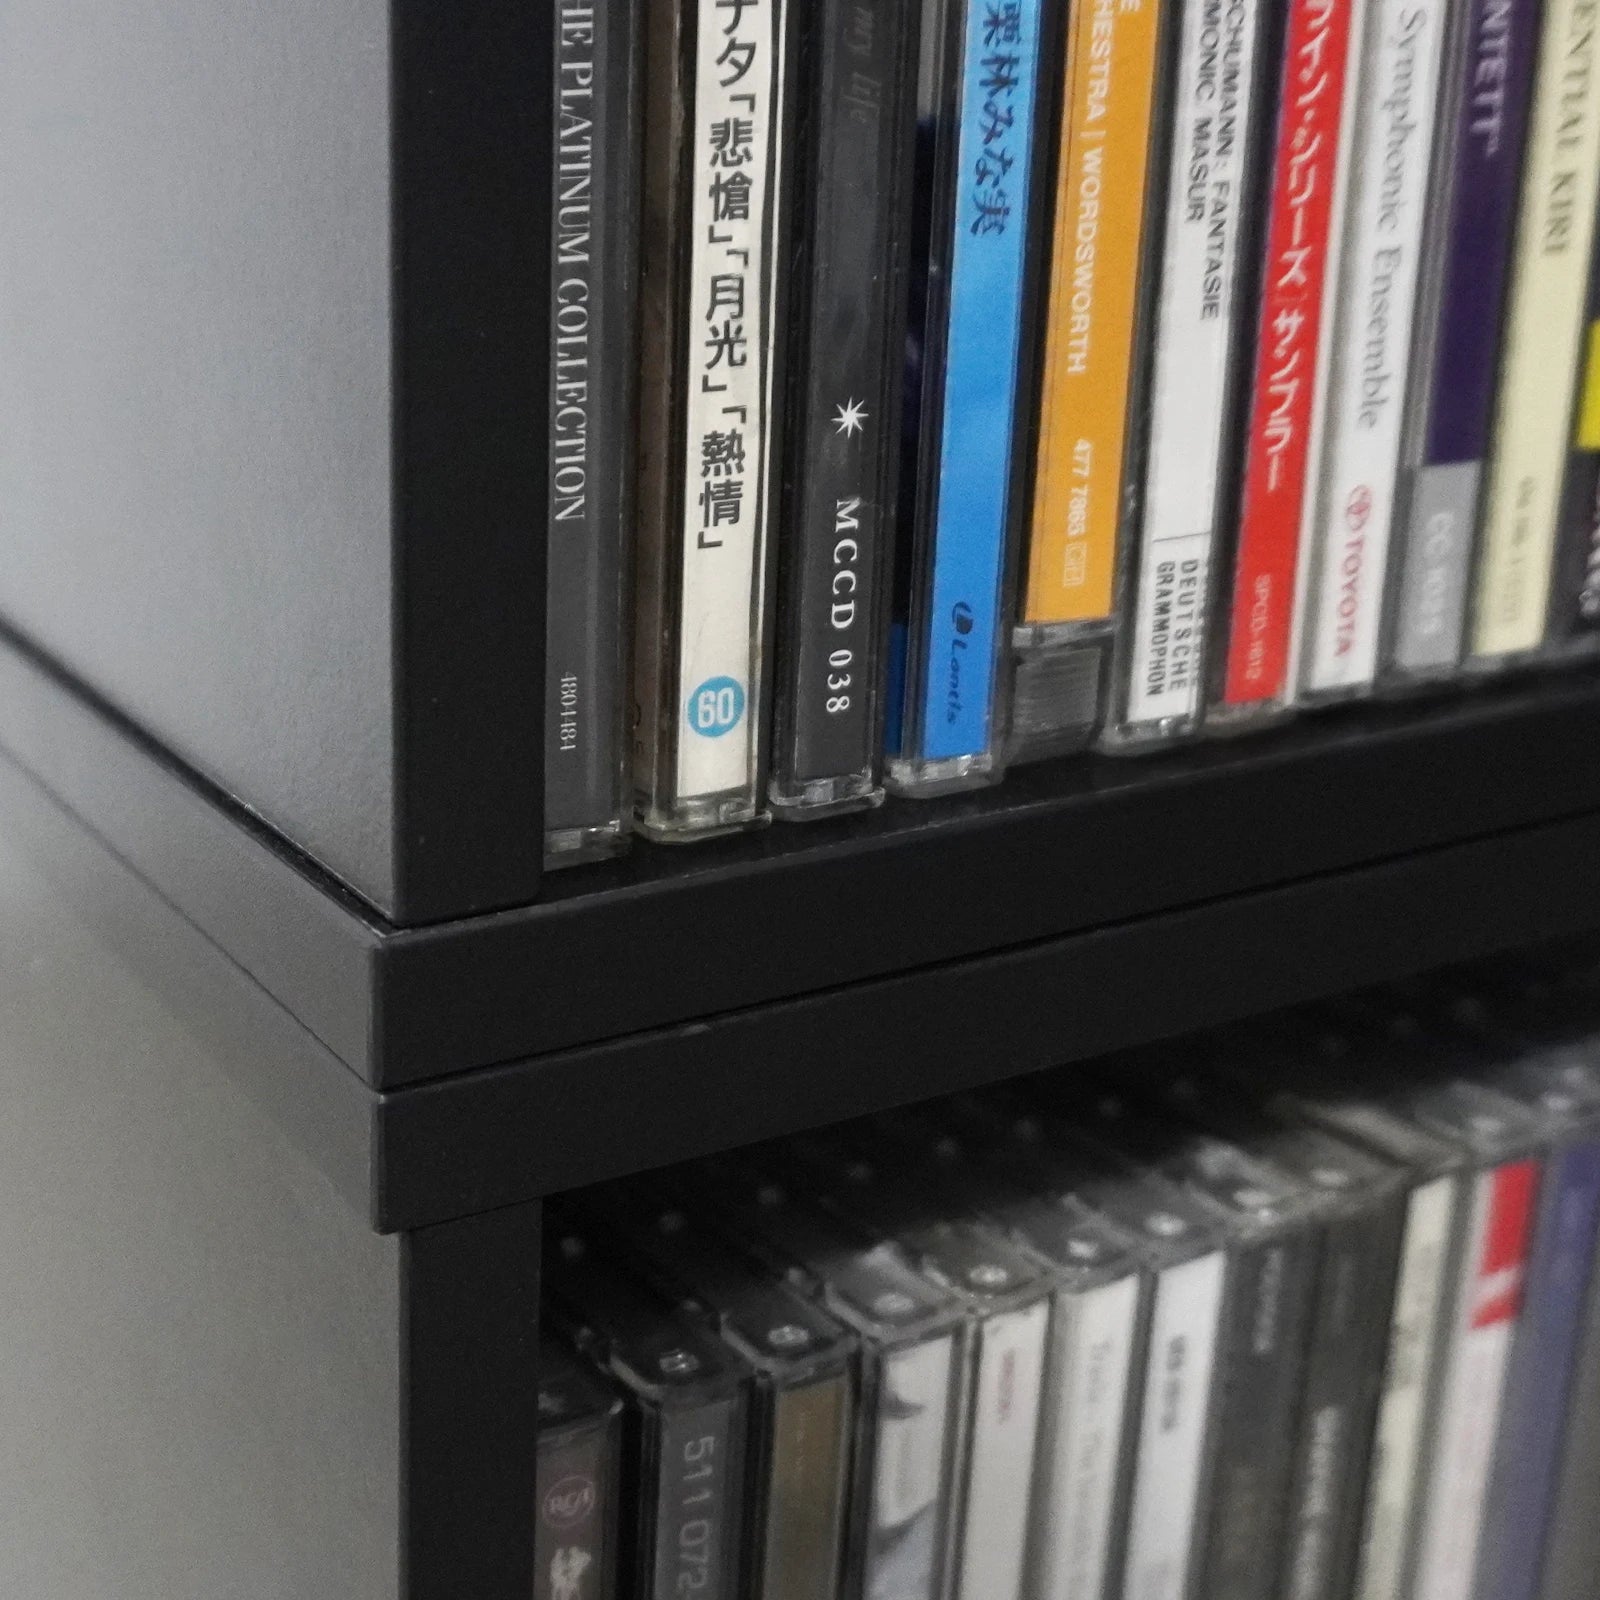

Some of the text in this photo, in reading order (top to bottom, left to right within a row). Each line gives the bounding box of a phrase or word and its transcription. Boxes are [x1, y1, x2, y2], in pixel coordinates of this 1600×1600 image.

[558, 61, 594, 264] PLATINUM
[1186, 117, 1213, 223] MASUR
[1201, 0, 1246, 321] CHUMANN: FANTASIE
[1357, 8, 1426, 430] Symphonic Ensemble
[1067, 147, 1105, 374] WORDSWORTH
[554, 278, 589, 521] COLLECTION
[825, 497, 860, 713] MCCD 038
[1146, 561, 1176, 697] GRAMMOPHON
[1169, 559, 1200, 693] DEUTSCHE
[1334, 537, 1364, 657] TOYOTA
[697, 687, 735, 729] 60
[683, 1436, 715, 1506] 511
